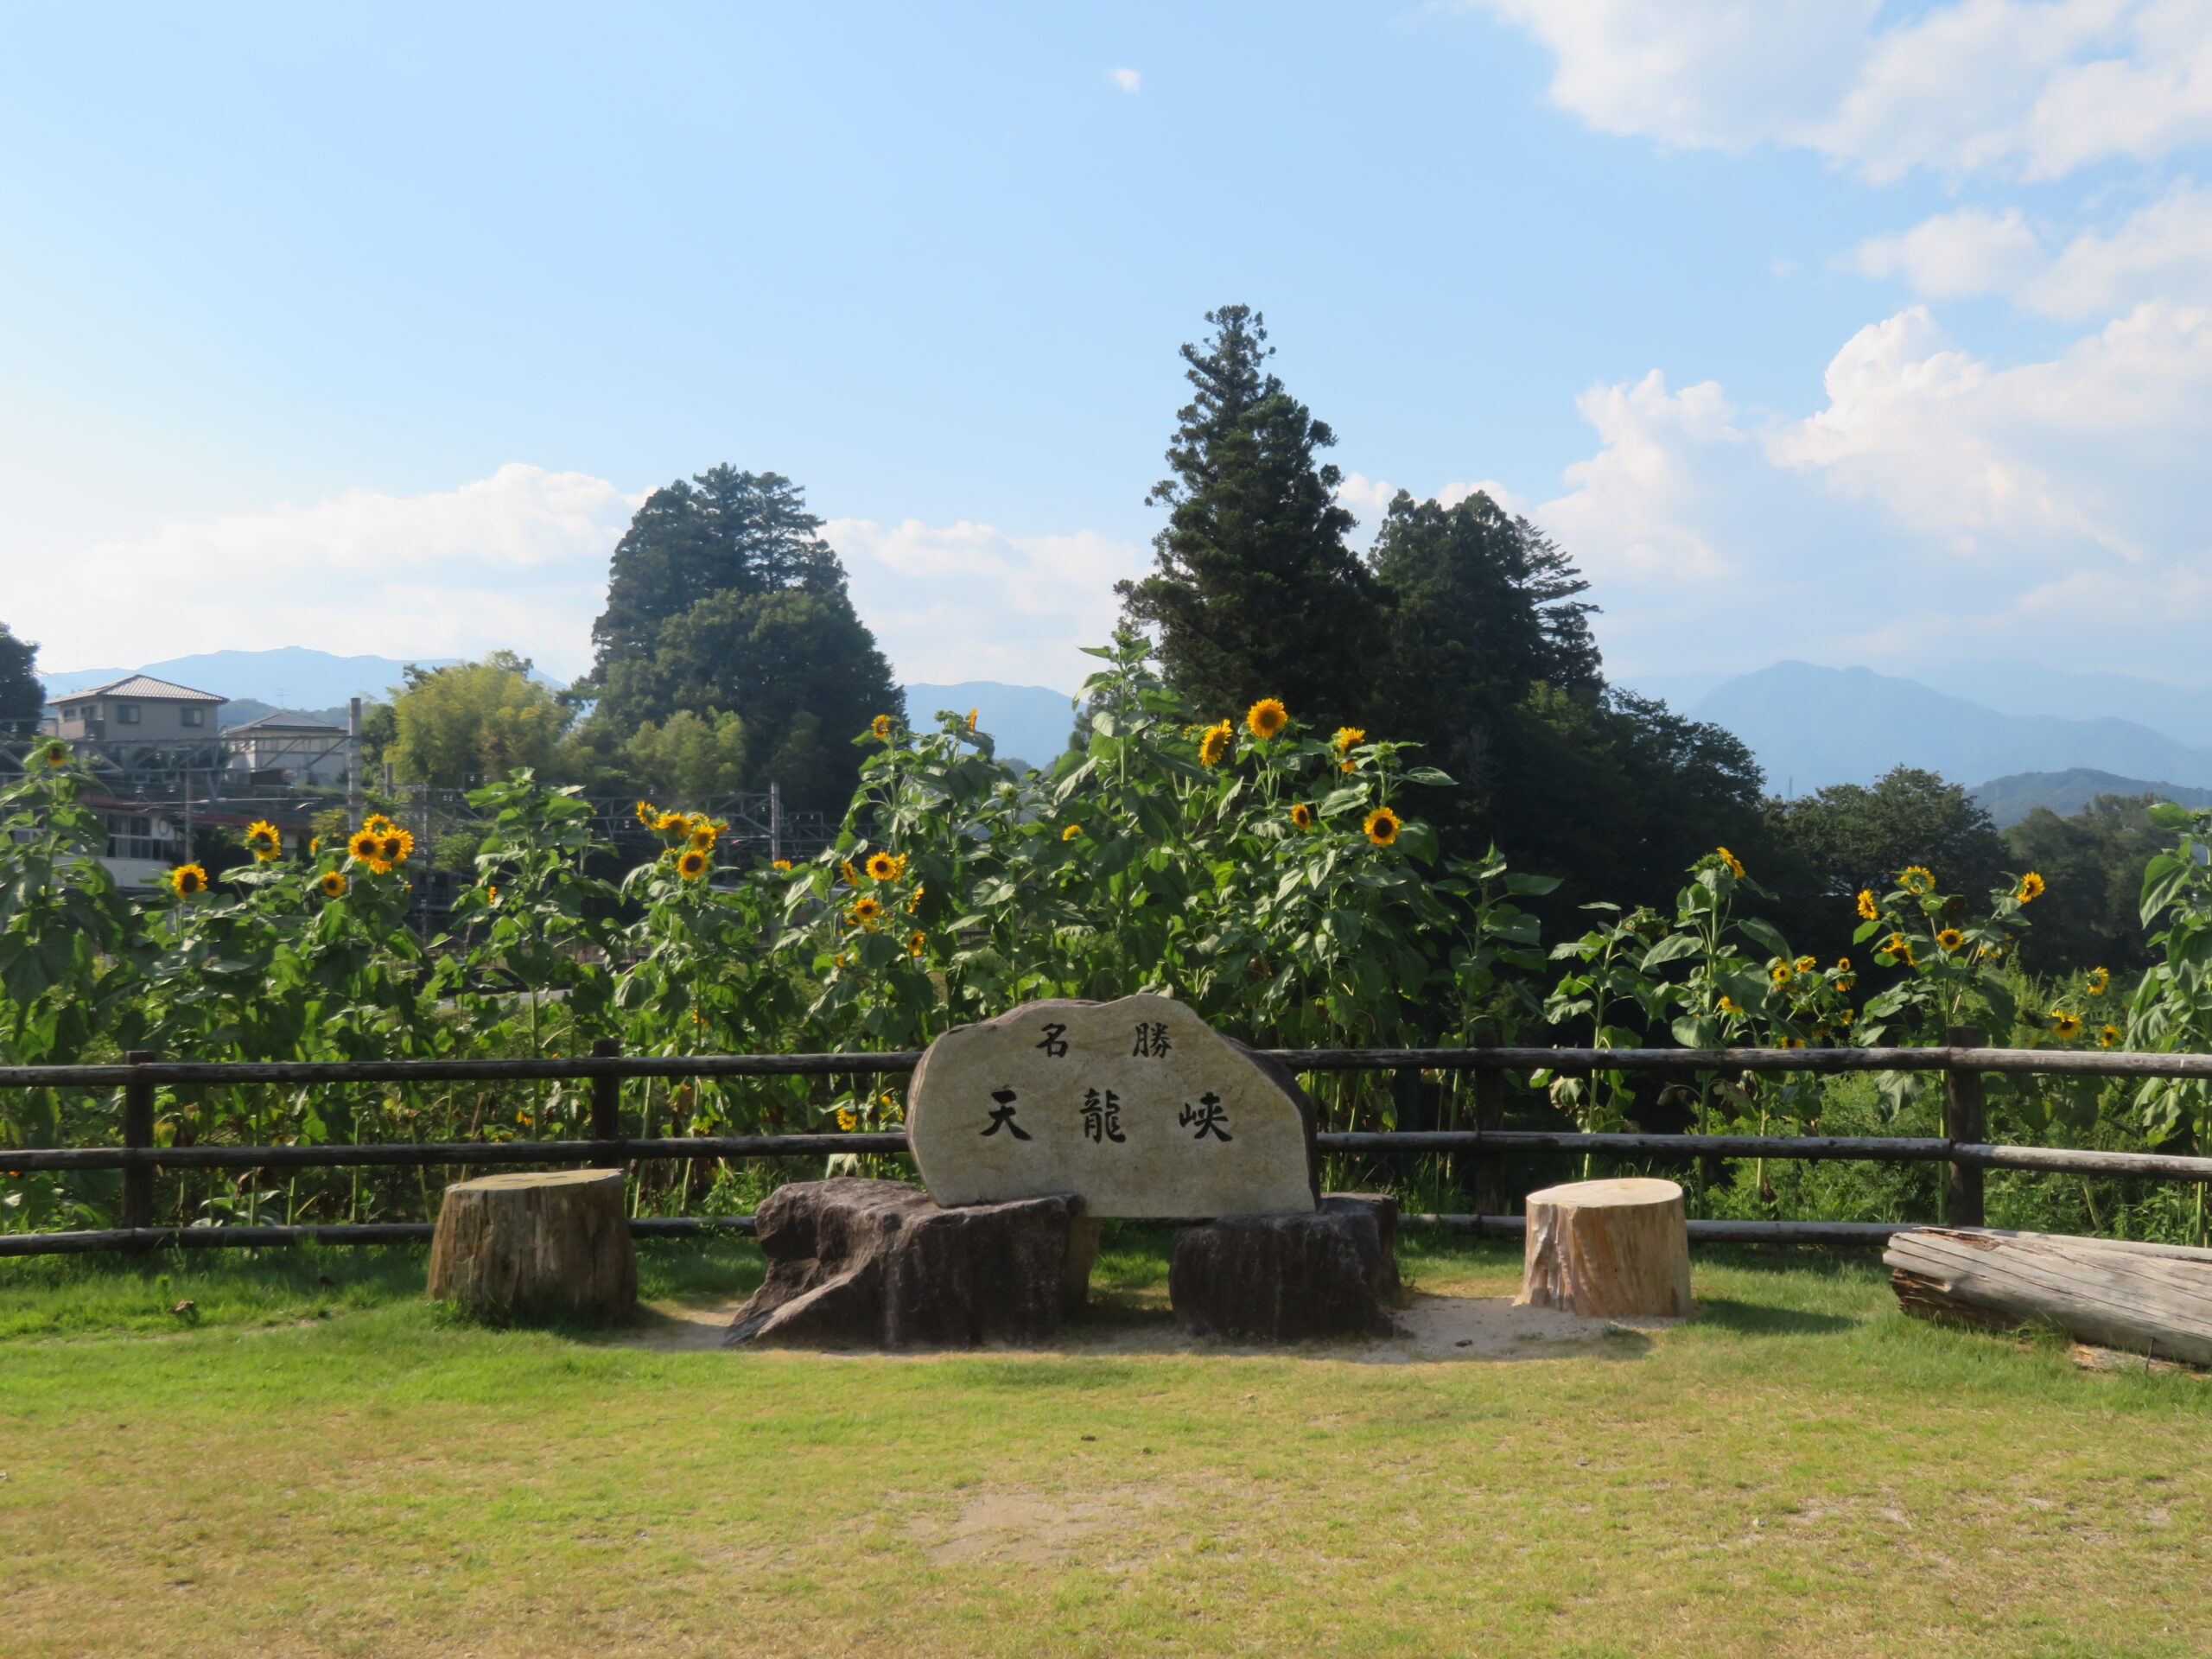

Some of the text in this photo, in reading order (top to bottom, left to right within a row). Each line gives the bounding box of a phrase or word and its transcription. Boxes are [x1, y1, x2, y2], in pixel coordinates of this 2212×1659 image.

[1035, 1022, 1173, 1058] 名勝
[979, 1088, 1233, 1144] 天龍峡
